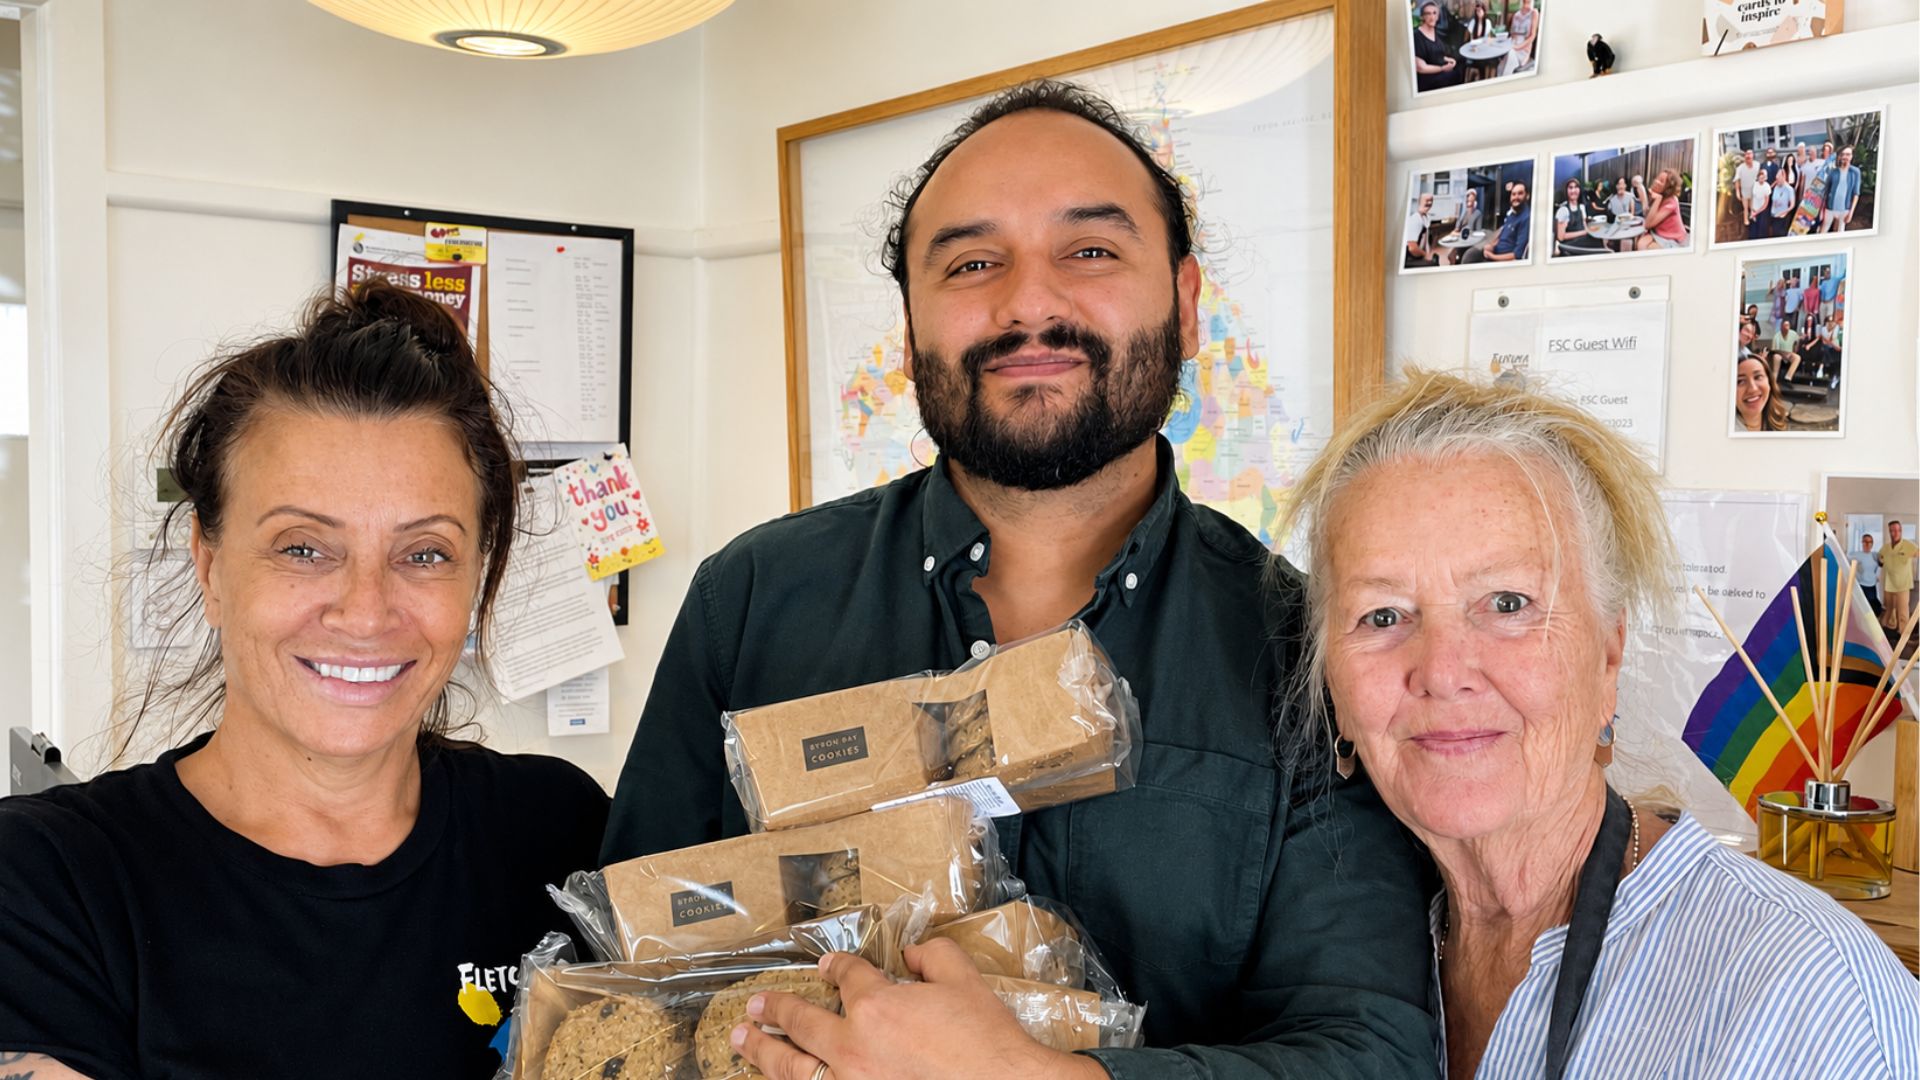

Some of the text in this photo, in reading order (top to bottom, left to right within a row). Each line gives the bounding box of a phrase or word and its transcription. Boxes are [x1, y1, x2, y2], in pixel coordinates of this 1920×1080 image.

[1741, 7, 1781, 22] inspire
[424, 271, 466, 293] less
[1549, 335, 1638, 352] FSC Guest Wifi
[1600, 394, 1629, 406] Guest
[568, 464, 631, 506] thank
[590, 500, 629, 532] you
[1707, 585, 1720, 596] be
[1755, 590, 1766, 600] to
[811, 745, 860, 763] COOKIES
